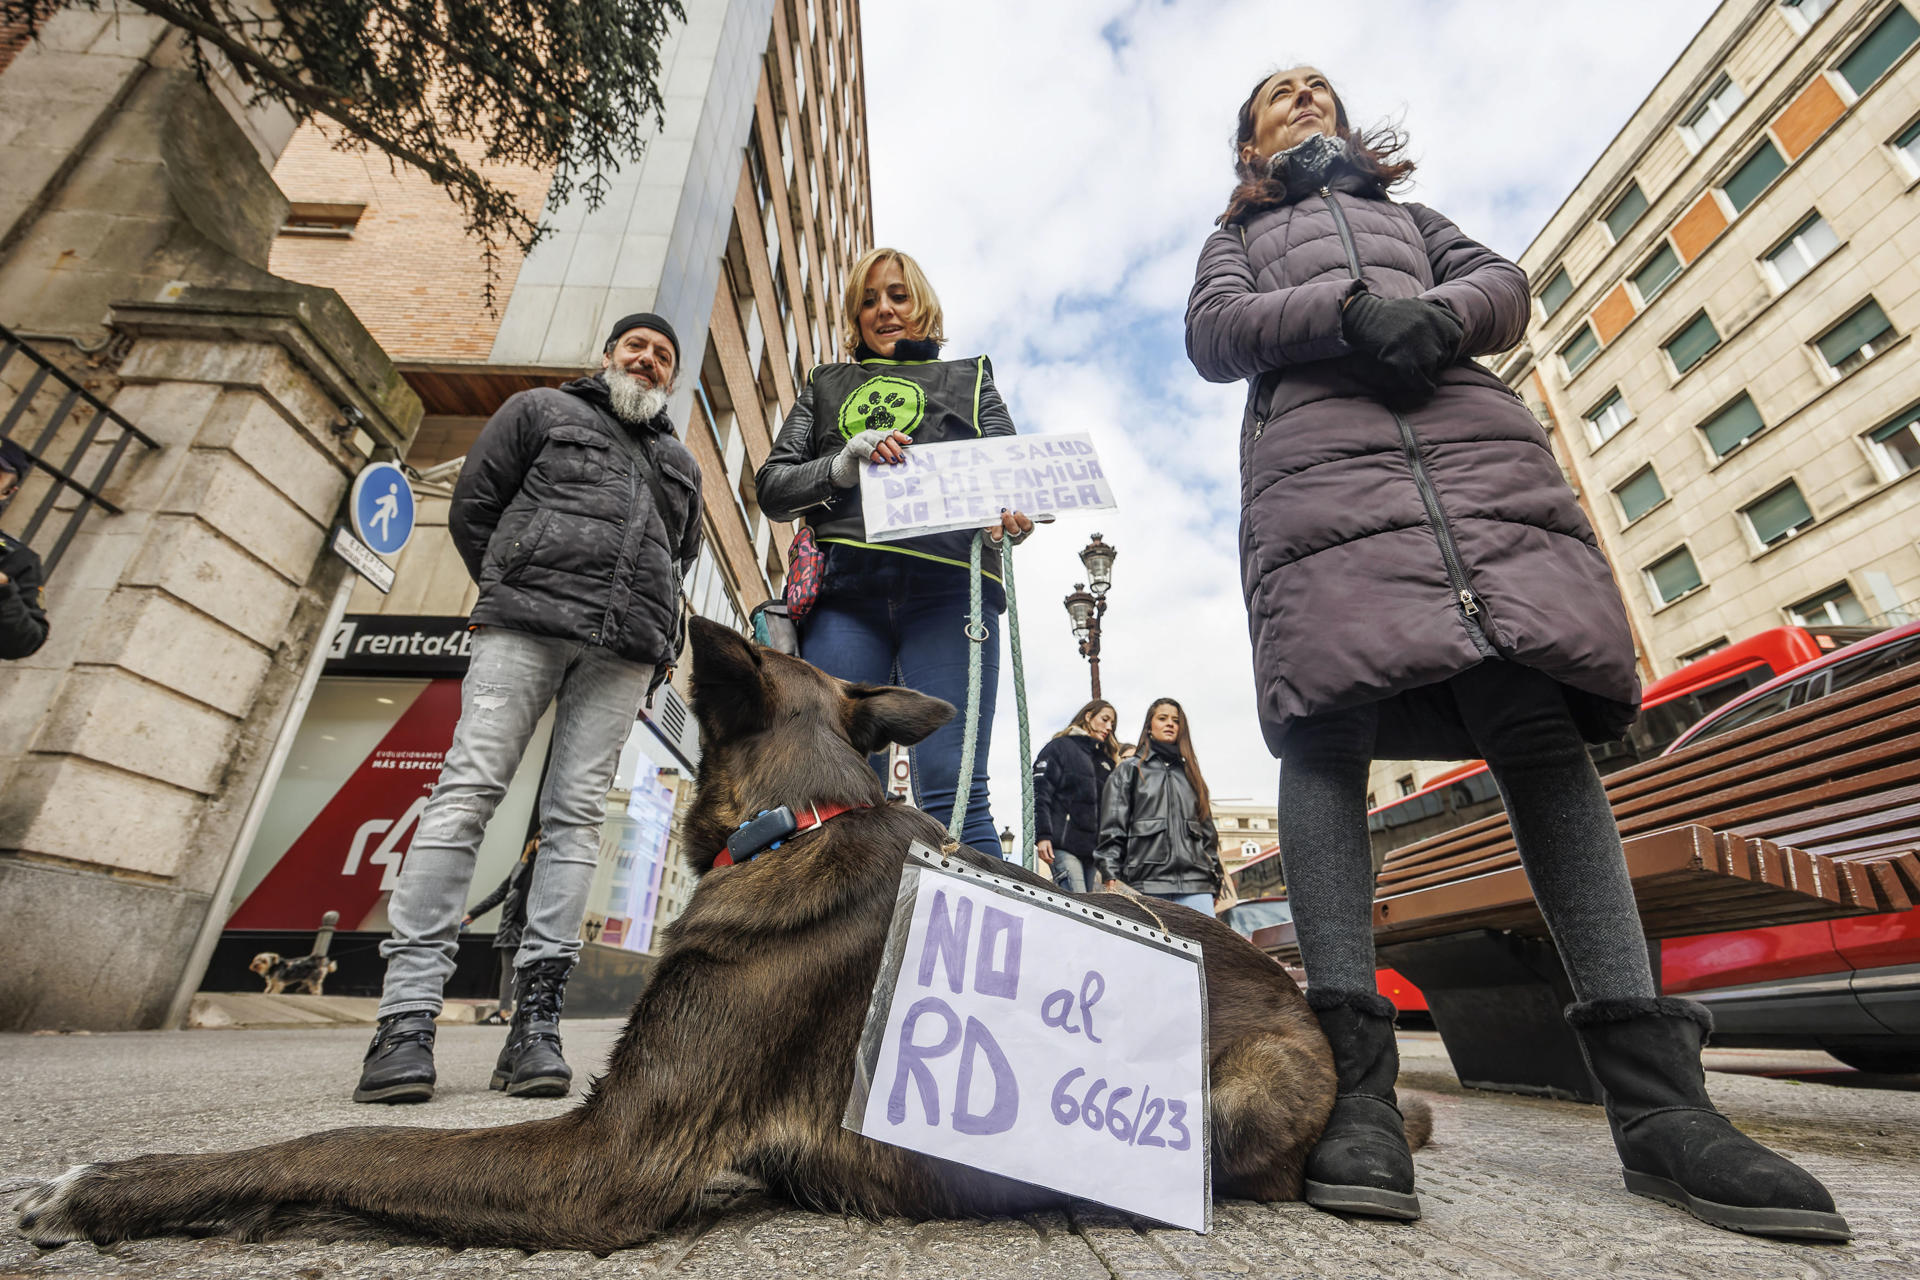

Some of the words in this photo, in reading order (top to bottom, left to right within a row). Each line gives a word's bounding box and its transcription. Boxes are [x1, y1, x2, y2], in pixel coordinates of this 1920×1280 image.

[949, 447, 994, 468] LA
[1006, 440, 1093, 461] SALUD
[883, 476, 924, 500] DE
[886, 501, 930, 527] NO
[994, 484, 1103, 516] JUEGA
[371, 759, 396, 769] MÁS
[375, 750, 443, 759] EVOLUCIONAMOS
[918, 889, 1024, 1000] NO
[1041, 970, 1106, 1044] al
[887, 997, 1020, 1136] RD
[1050, 1067, 1192, 1151] 666/23
